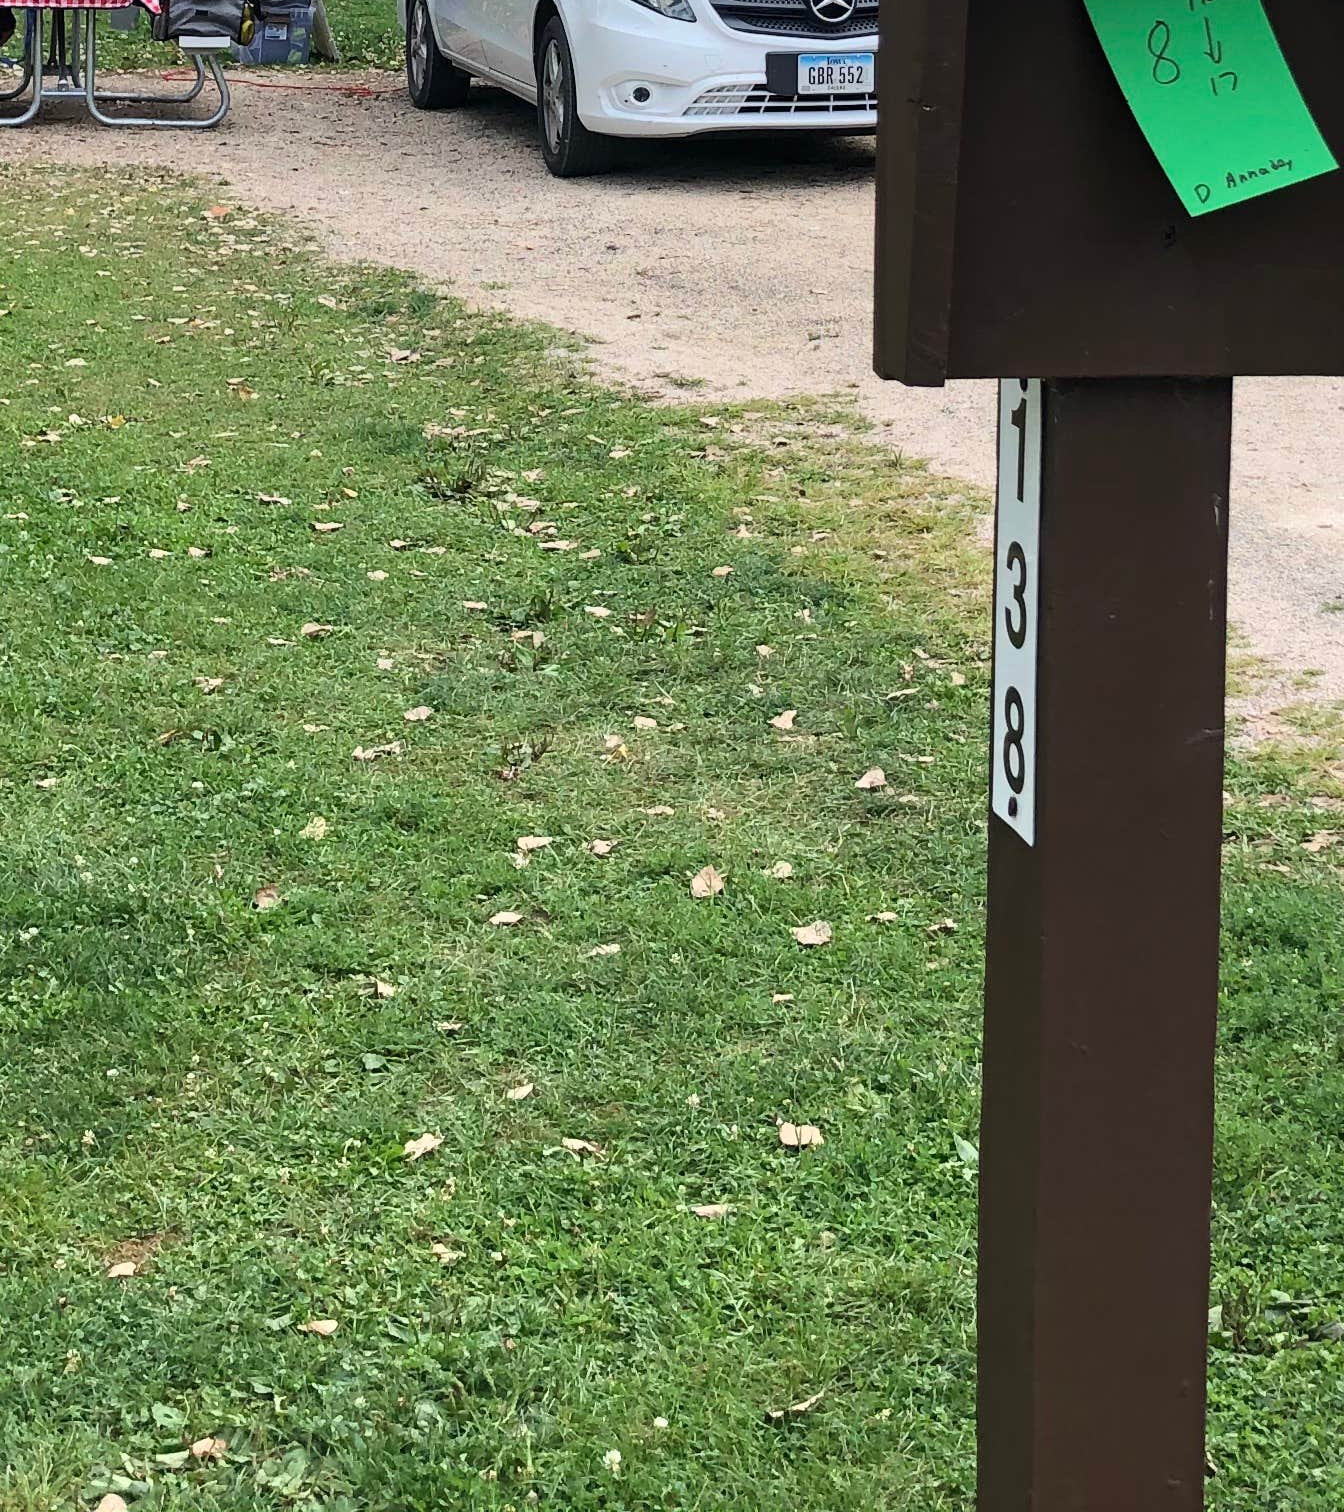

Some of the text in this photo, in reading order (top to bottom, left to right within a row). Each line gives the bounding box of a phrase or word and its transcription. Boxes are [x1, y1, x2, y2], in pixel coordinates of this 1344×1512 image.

[1147, 20, 1181, 85] 8
[808, 66, 864, 85] GBR 552
[1210, 71, 1238, 96] 17
[1194, 183, 1211, 204] D
[1003, 397, 1027, 795] 138
